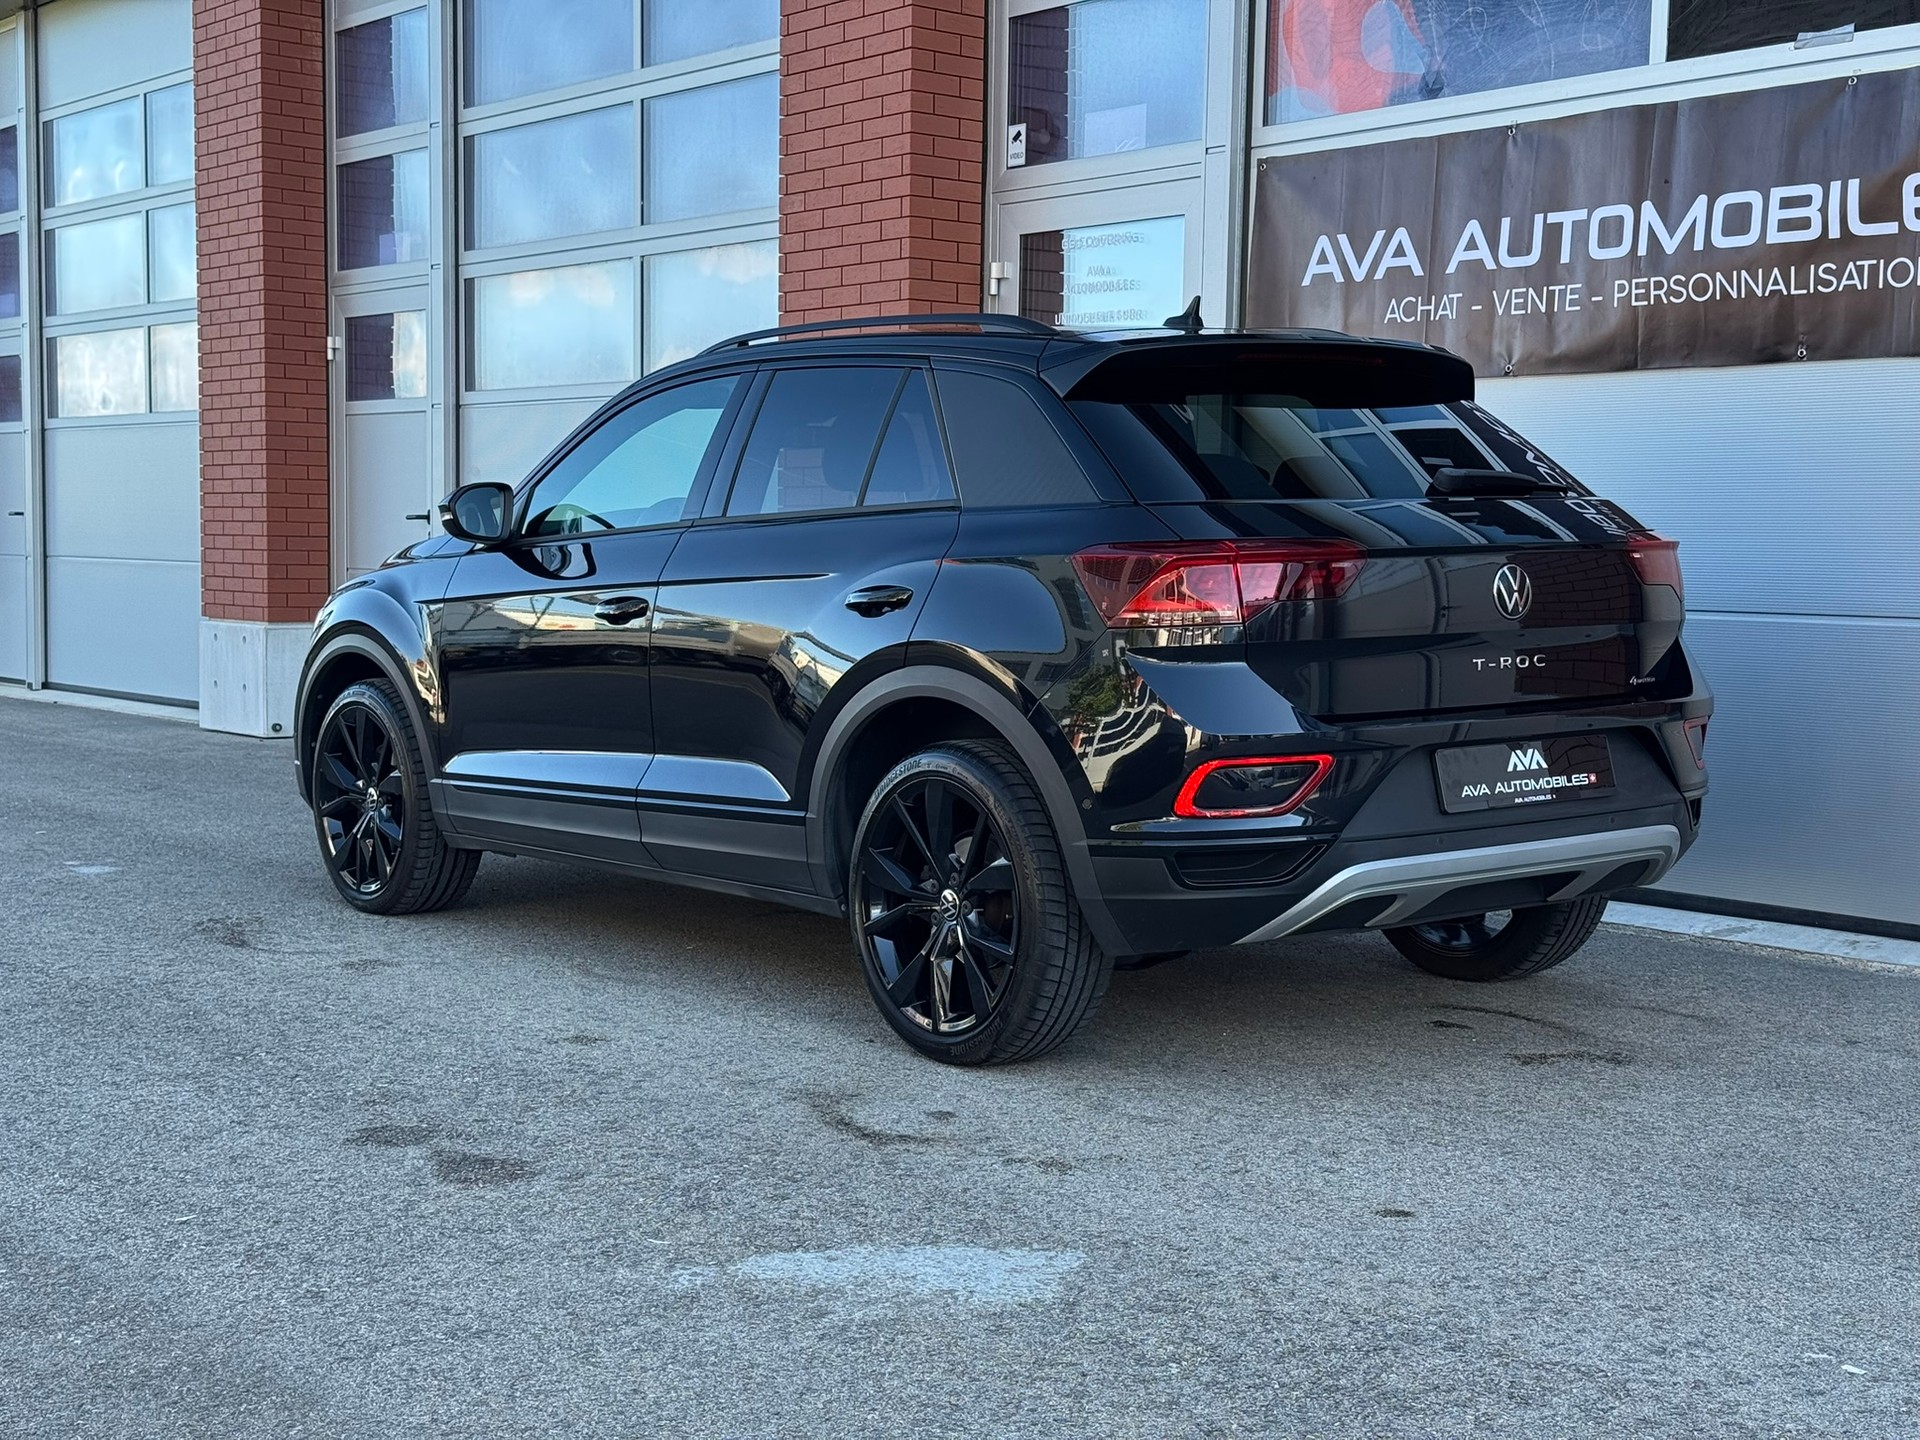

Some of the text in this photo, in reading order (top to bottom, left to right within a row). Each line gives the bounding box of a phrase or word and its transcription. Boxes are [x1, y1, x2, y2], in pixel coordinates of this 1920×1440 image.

[1009, 152, 1024, 160] VIDEO
[1301, 227, 1424, 286] AVA
[1384, 293, 1463, 323] ACHAT
[1493, 284, 1582, 316] VENTE
[1613, 257, 1920, 307] PERSONNALISATIO
[1472, 654, 1547, 671] T-ROC
[1507, 748, 1549, 772] AVA
[1461, 773, 1588, 797] AVA AUTOMOBILES
